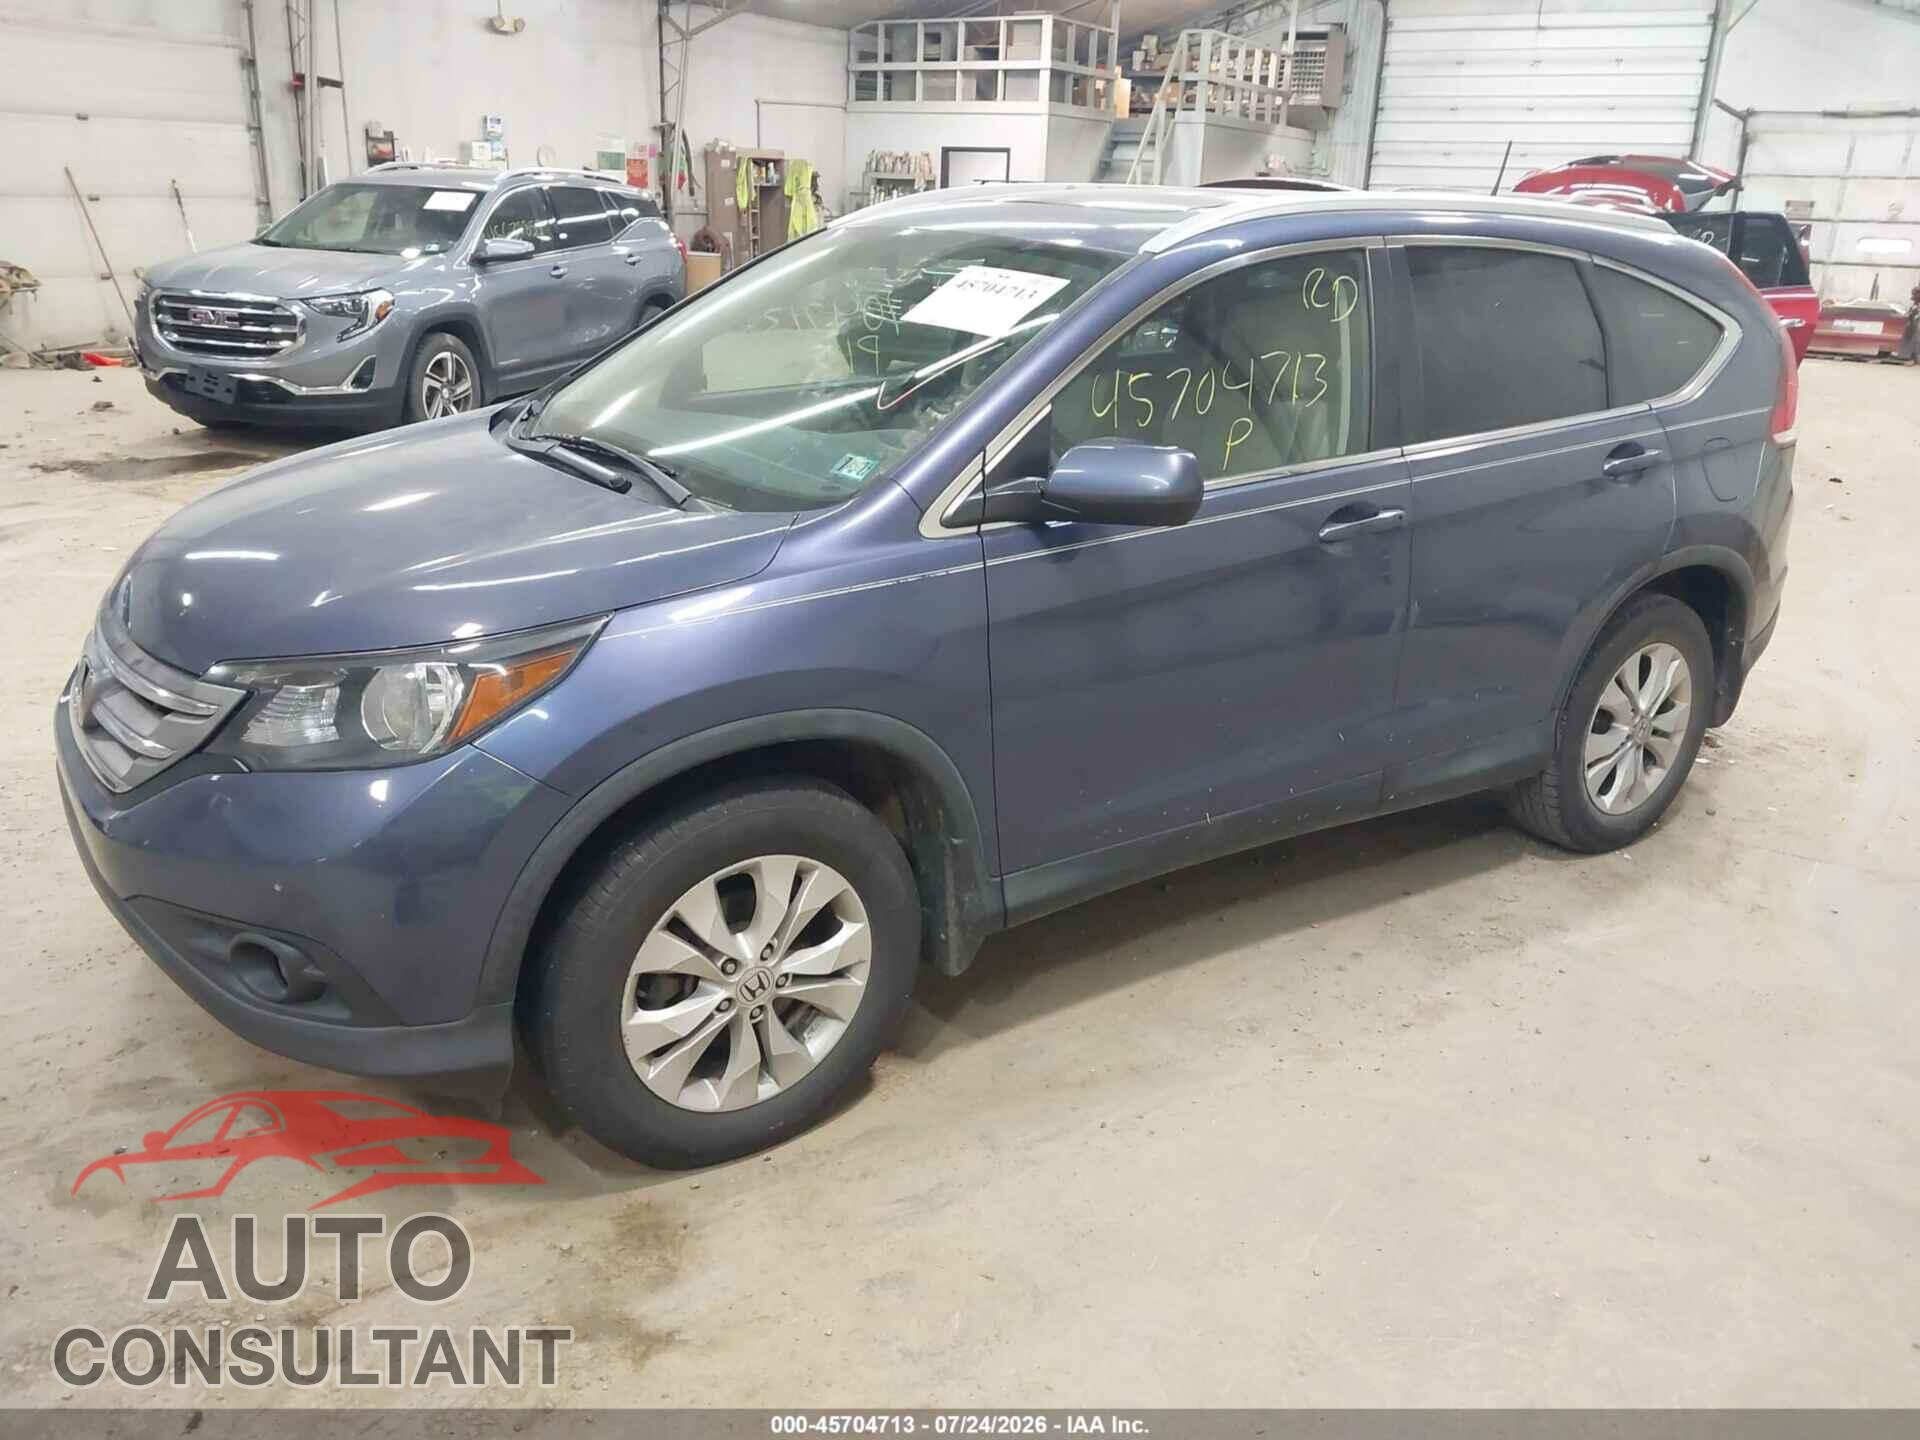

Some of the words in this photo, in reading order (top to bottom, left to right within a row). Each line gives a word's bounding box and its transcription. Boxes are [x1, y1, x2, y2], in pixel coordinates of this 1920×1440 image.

[190, 309, 240, 329] GMC
[1091, 351, 1328, 429] 45704713
[1222, 417, 1253, 471] P
